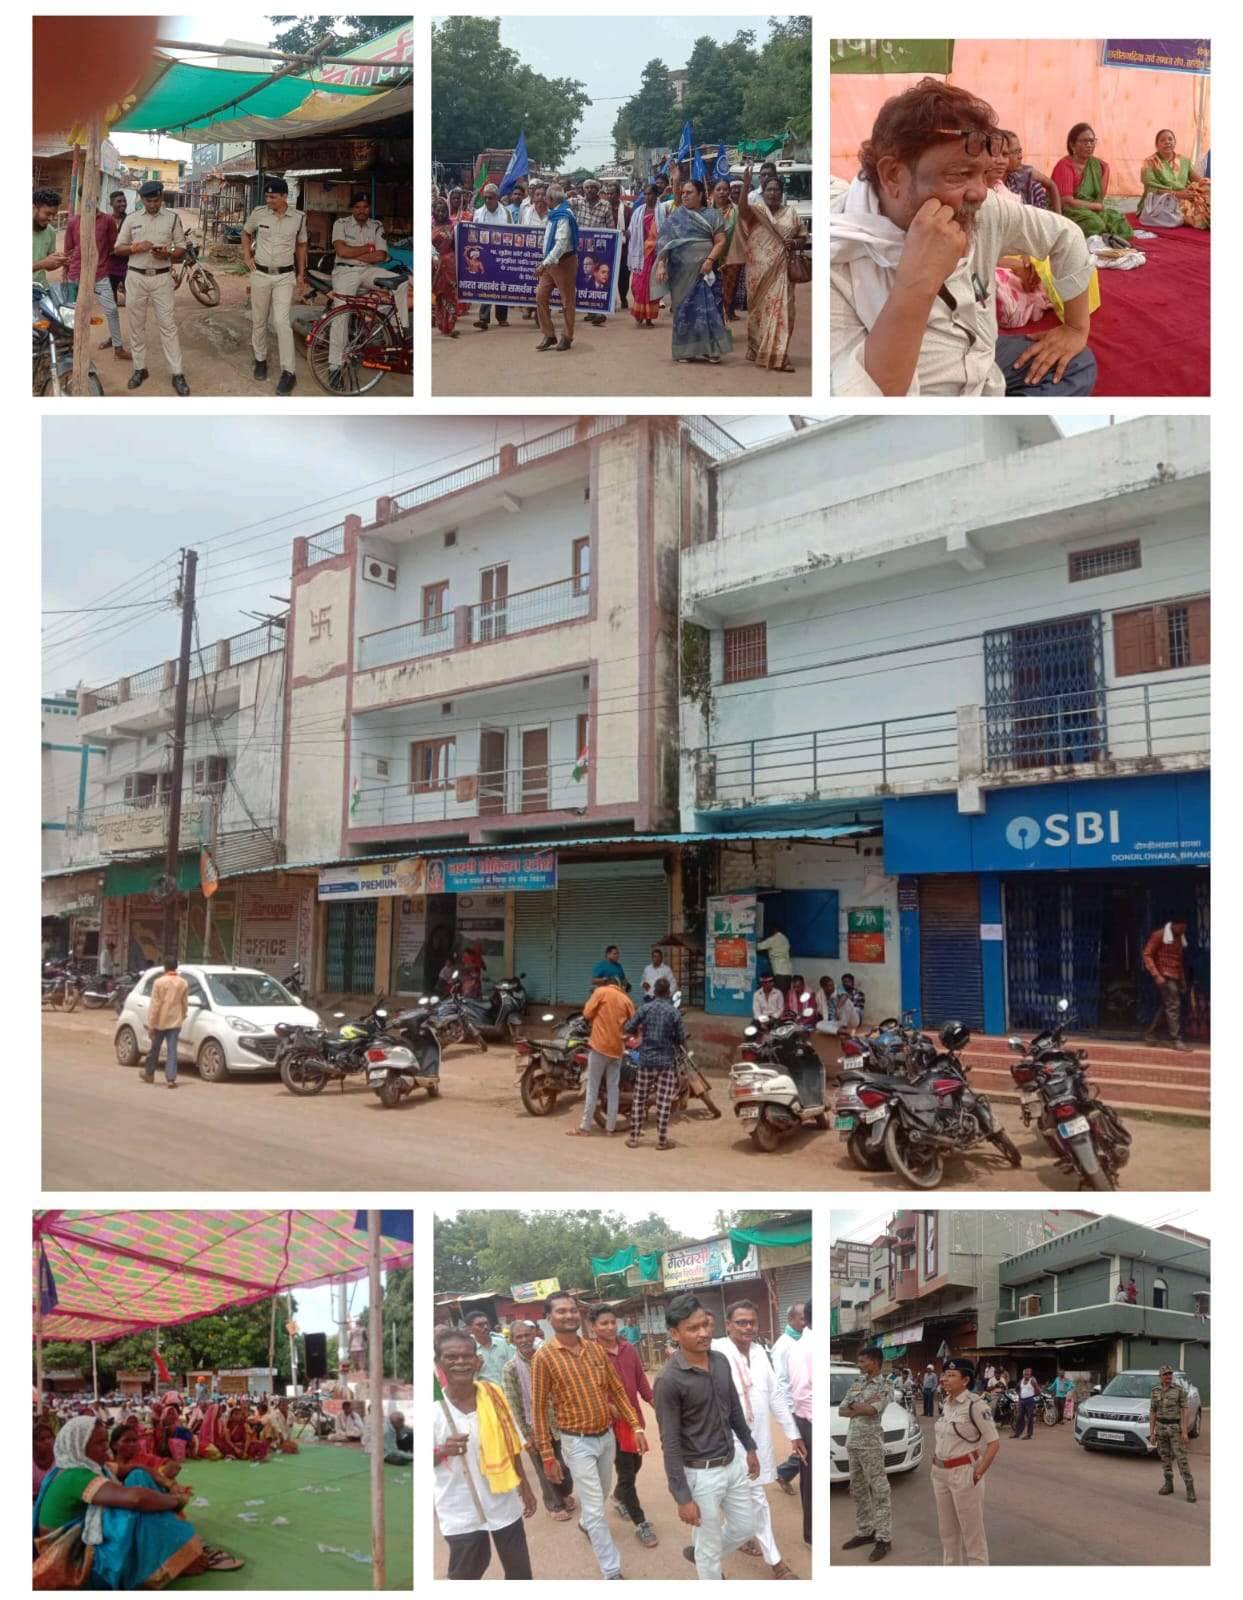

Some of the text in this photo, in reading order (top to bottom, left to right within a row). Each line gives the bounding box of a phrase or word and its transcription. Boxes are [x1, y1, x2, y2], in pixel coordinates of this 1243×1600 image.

[459, 280, 476, 289] भारत
[508, 283, 532, 294] समर्थन
[588, 290, 608, 300] ज्ञापन
[1044, 810, 1120, 847] SBI
[361, 879, 397, 890] PREMIUM
[246, 939, 287, 955] OFFICE
